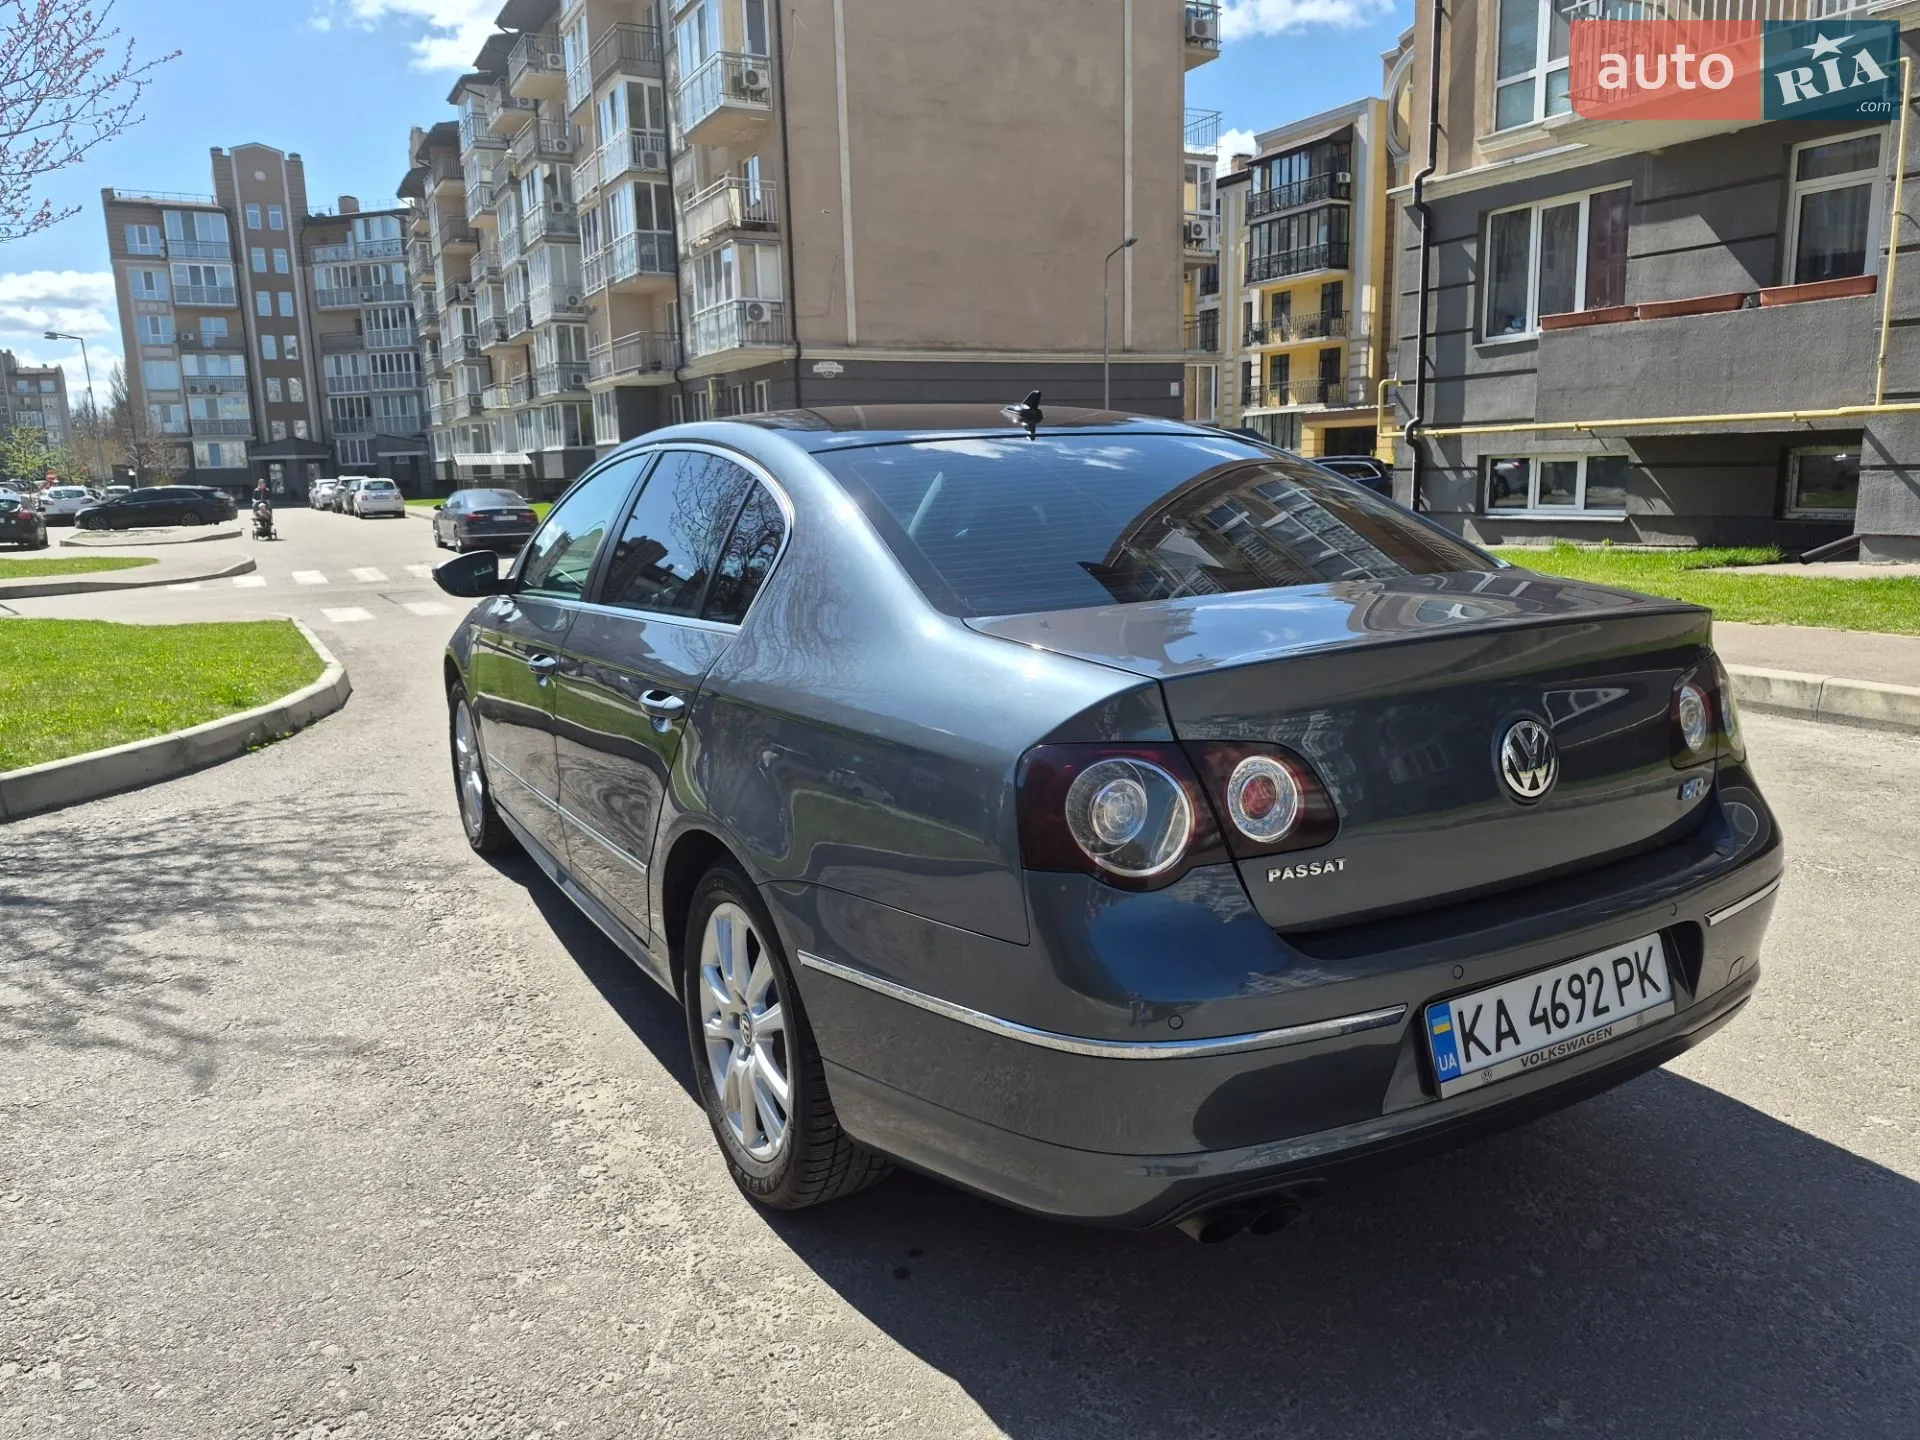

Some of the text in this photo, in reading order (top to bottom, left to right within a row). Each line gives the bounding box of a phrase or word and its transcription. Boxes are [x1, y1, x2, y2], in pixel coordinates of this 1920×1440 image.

[1267, 857, 1347, 882] PASSAT
[1458, 946, 1662, 1063] KA 4692 PK
[1437, 1051, 1457, 1072] UA
[1520, 1026, 1613, 1069] VOLKSWAGEN
